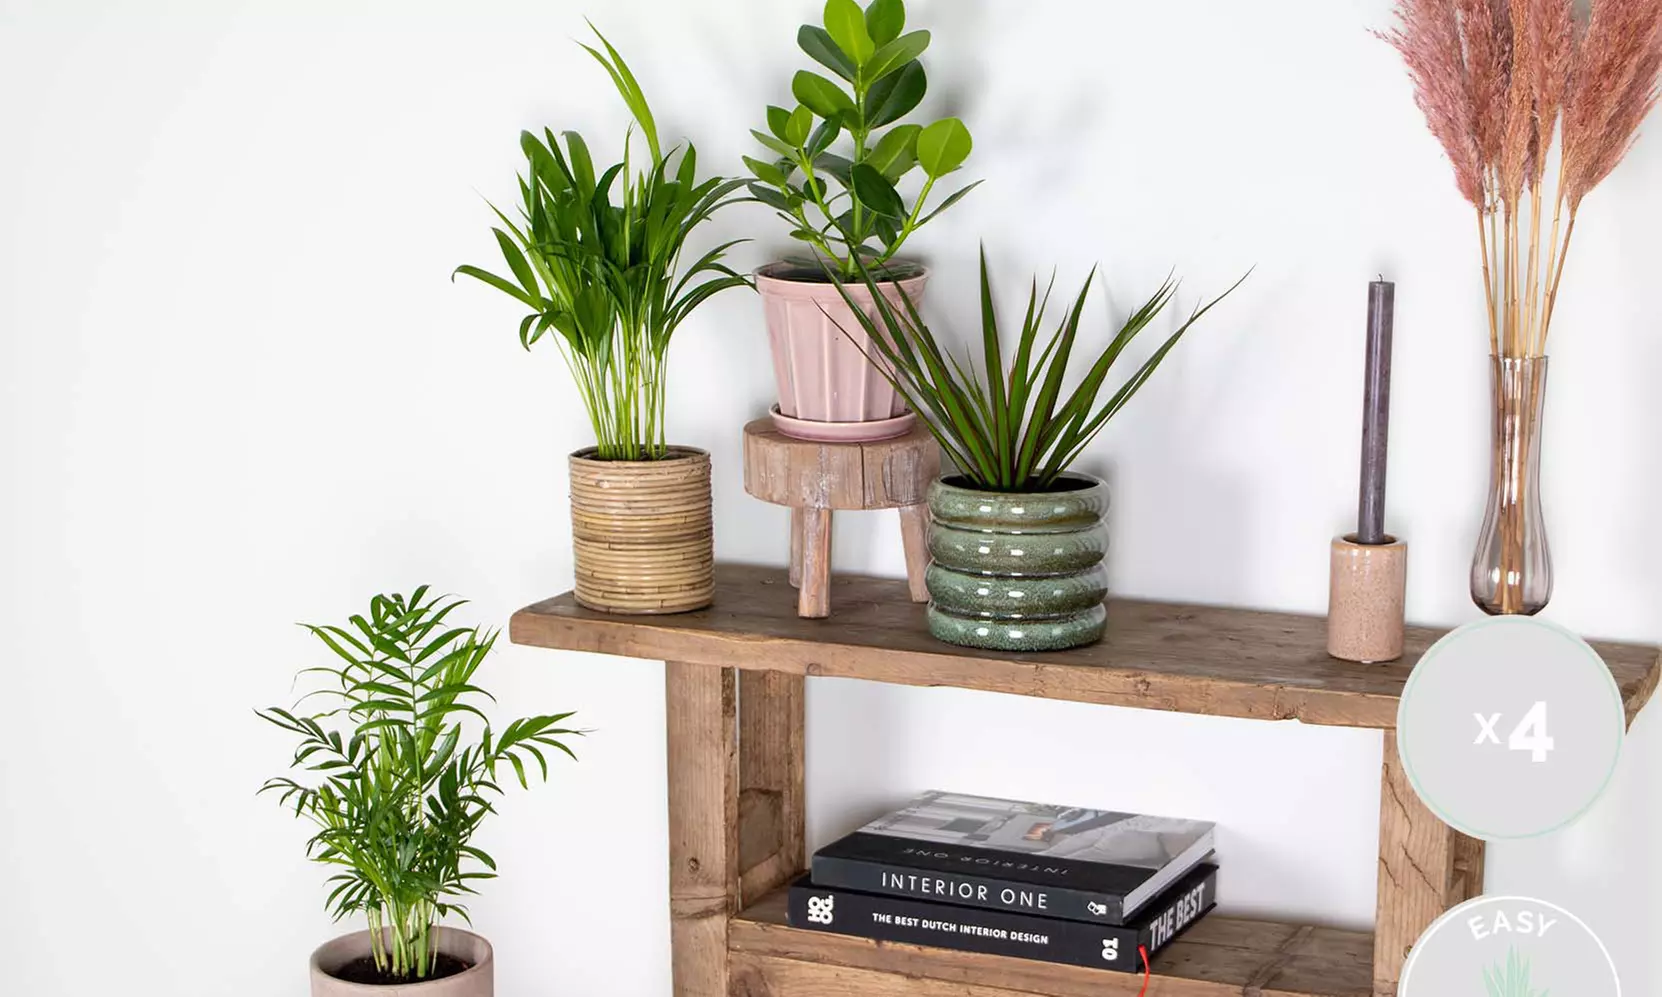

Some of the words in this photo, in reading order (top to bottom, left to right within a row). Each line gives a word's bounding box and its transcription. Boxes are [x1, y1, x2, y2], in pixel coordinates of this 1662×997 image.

[903, 847, 949, 859] ONE
[960, 855, 1069, 876] INTERIOR
[881, 871, 988, 901] INTERIOR
[1000, 888, 1048, 910] ONE
[872, 912, 892, 924] THE
[894, 915, 920, 927] BEST
[921, 919, 957, 932] DUTCH
[959, 924, 1008, 939] INTERIOR
[1010, 931, 1049, 945] DESIGN
[1149, 906, 1175, 952] THE
[1176, 882, 1205, 930] BEST
[1101, 937, 1119, 961] 01
